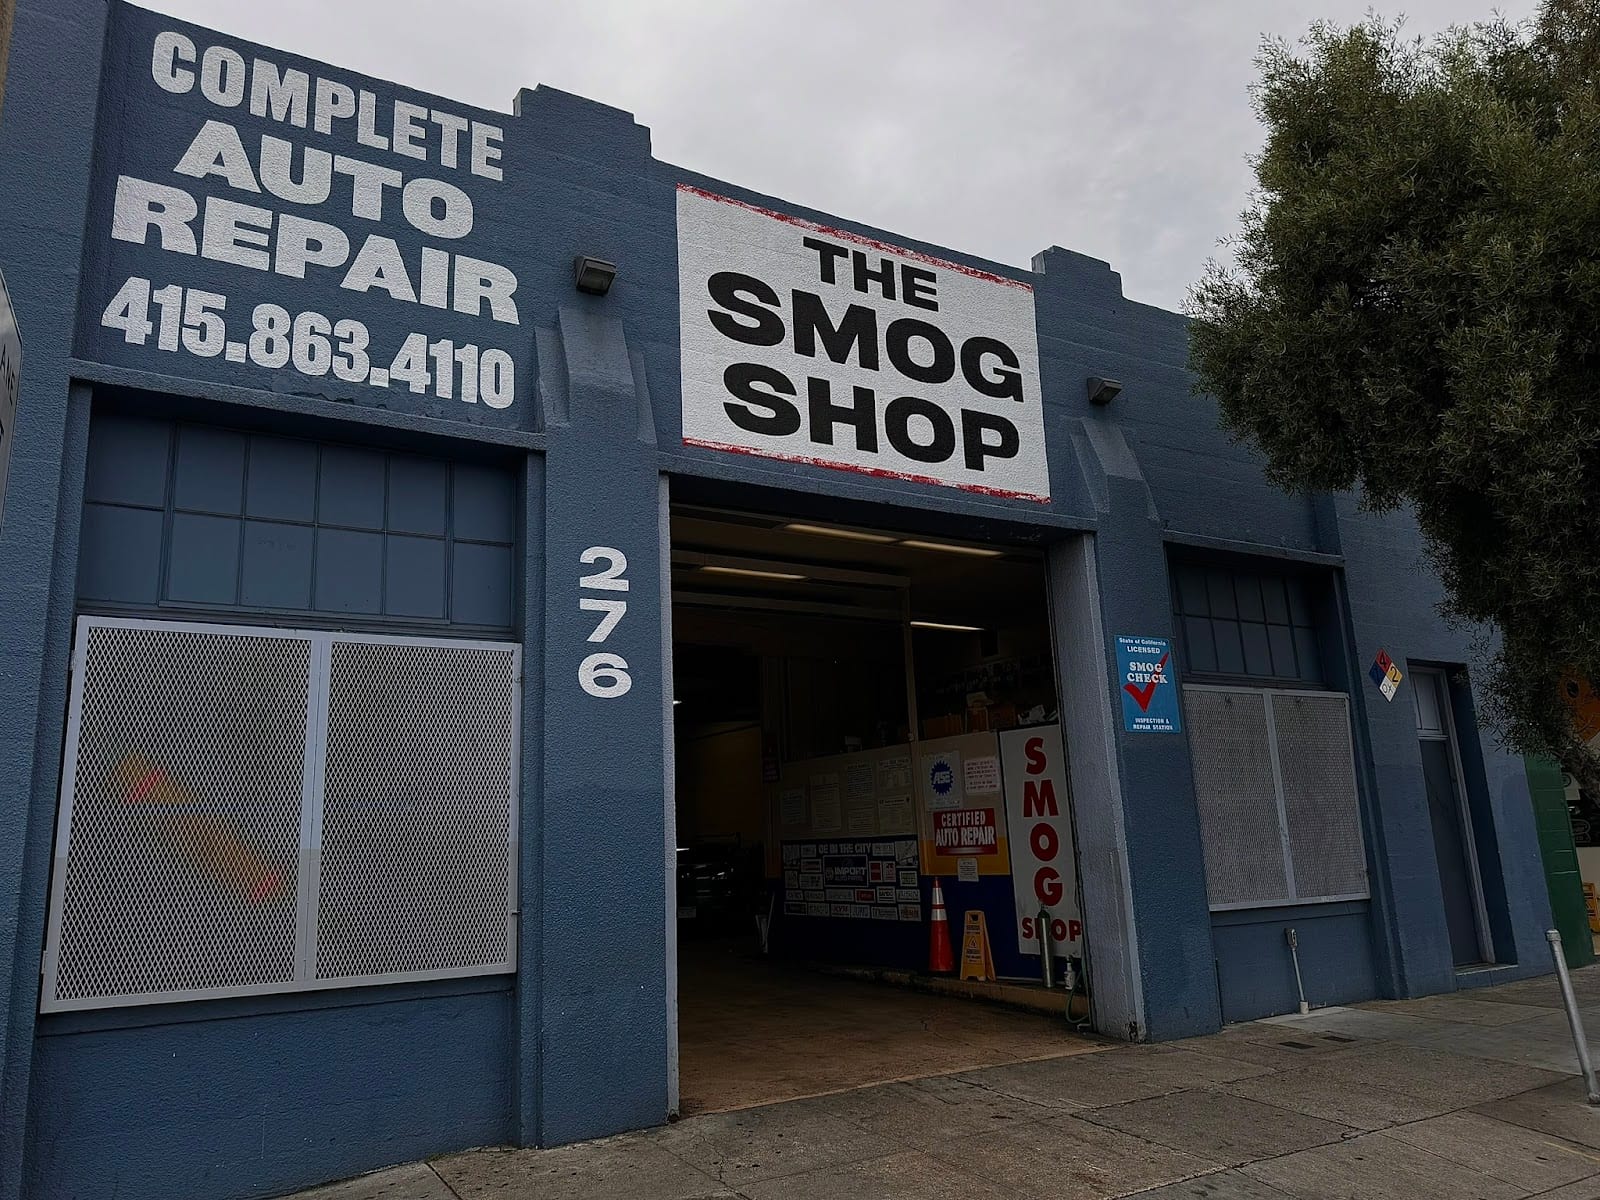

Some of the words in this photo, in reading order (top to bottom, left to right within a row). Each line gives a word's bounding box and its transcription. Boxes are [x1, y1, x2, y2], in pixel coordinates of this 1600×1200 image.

[152, 31, 503, 181] COMPLETE
[174, 120, 473, 239] AUTO
[112, 175, 519, 325] REPAIR
[803, 236, 939, 312] THE
[101, 276, 515, 409] 415.863.4110
[707, 271, 1024, 403] SMOG
[723, 362, 1020, 471] SHOP
[578, 546, 632, 698] 276
[1126, 646, 1161, 654] LICENSED
[1141, 639, 1167, 647] California
[1126, 672, 1168, 684] CHECK
[1129, 661, 1163, 672] SMOG
[1390, 666, 1399, 682] 2
[854, 842, 872, 854] CITY
[935, 828, 959, 847] AUTO
[960, 825, 996, 846] REPAIR
[941, 810, 986, 827] CERTIFIED
[1023, 737, 1063, 907] SMOG
